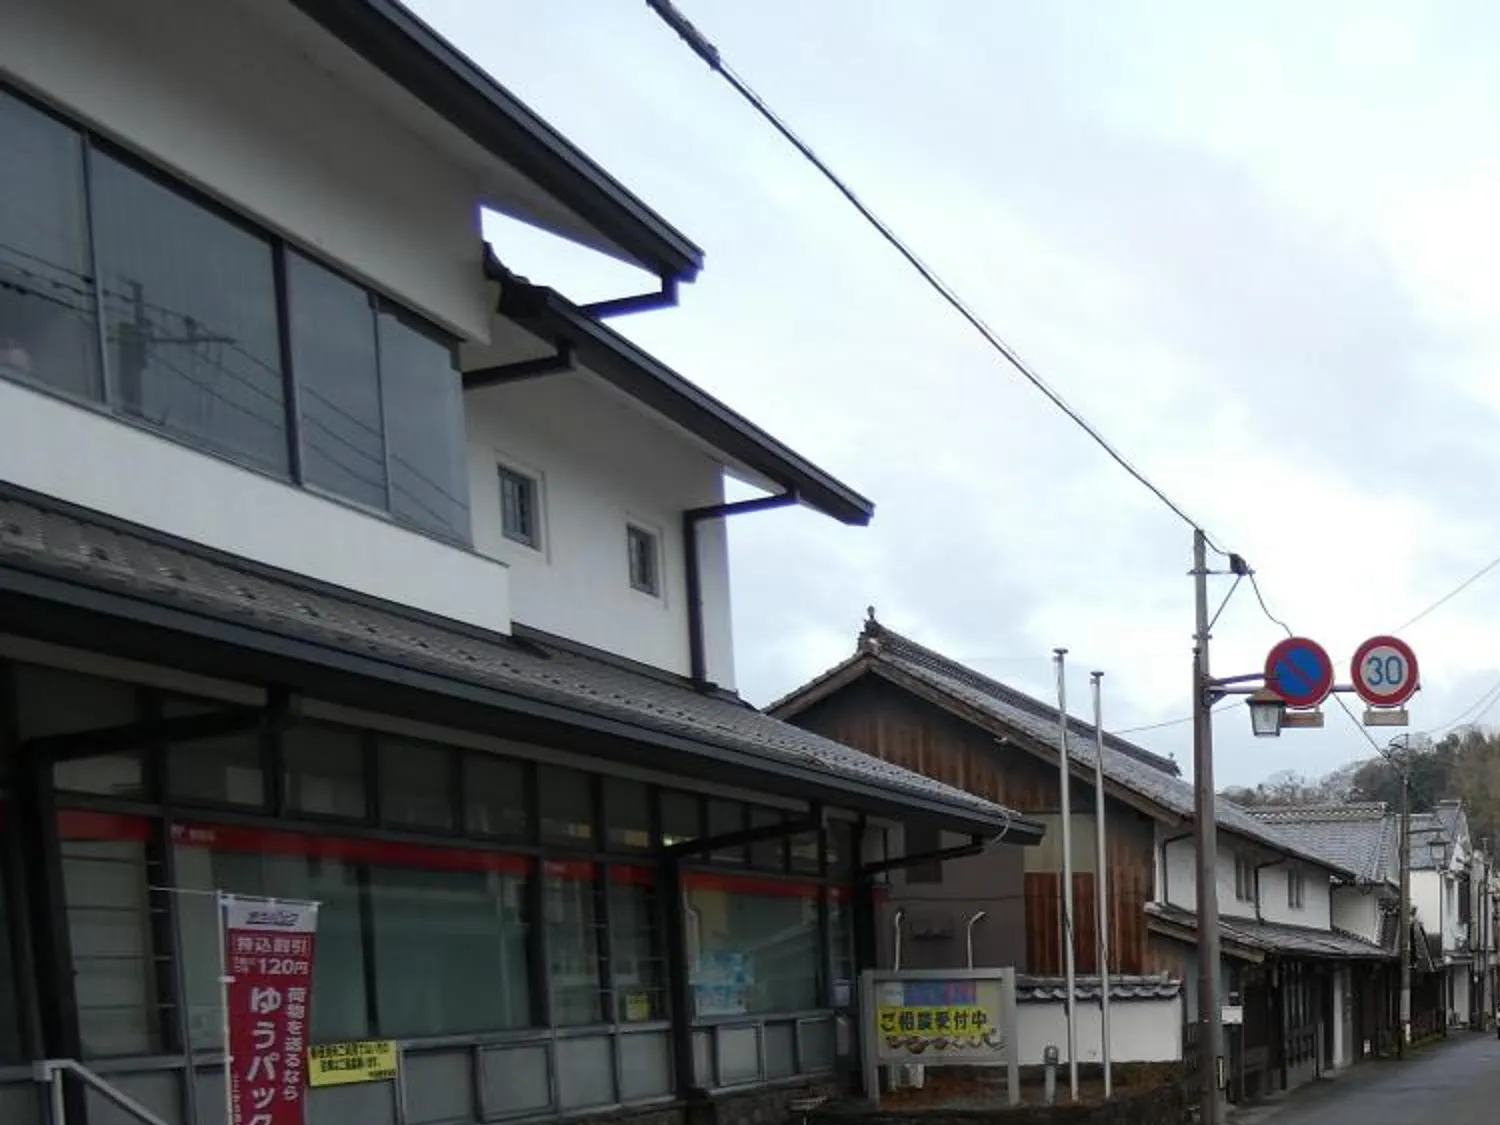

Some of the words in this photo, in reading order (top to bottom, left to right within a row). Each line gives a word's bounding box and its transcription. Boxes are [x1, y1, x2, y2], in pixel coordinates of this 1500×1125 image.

[1366, 655, 1403, 686] 30
[260, 957, 309, 975] 120円
[880, 1008, 988, 1032] ご相談受付中
[283, 986, 307, 1101] 荷物を送るなら
